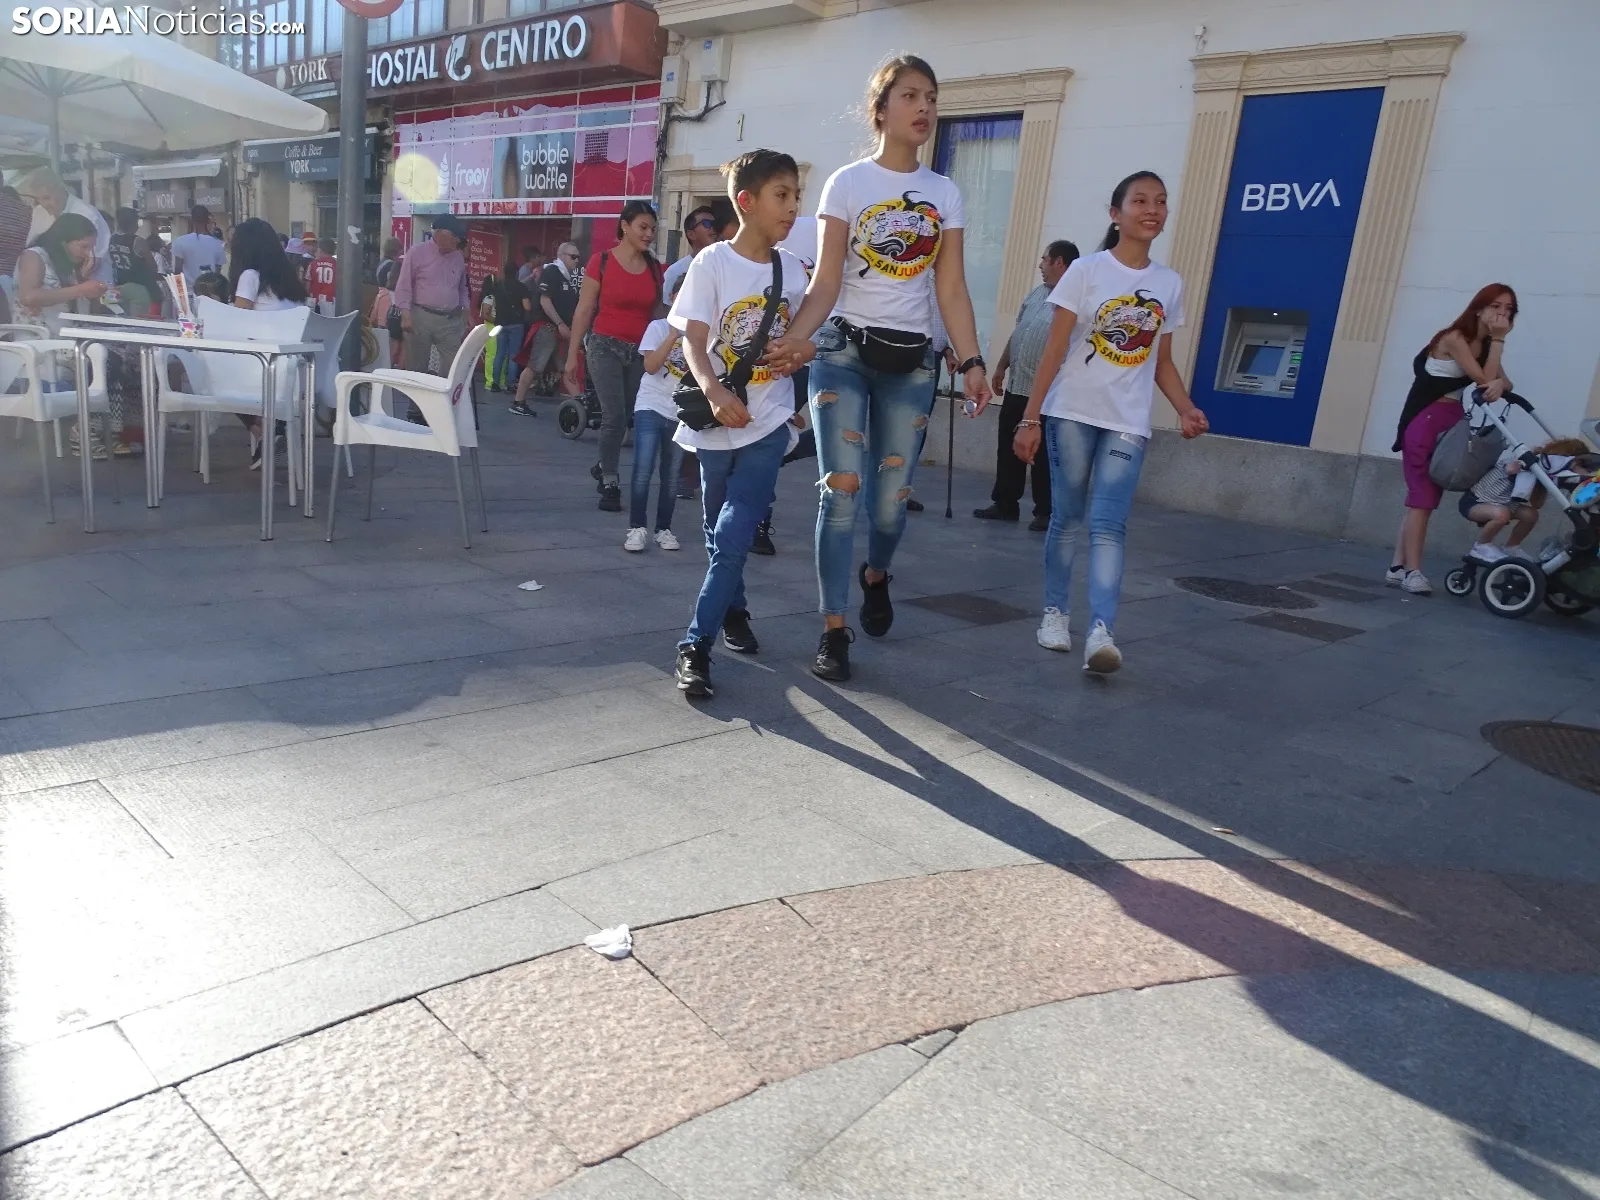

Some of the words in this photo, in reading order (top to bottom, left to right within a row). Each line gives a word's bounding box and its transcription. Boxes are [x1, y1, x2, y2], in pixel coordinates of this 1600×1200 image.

[480, 15, 587, 71] CENTRO
[290, 58, 328, 86] YORK
[522, 141, 569, 166] bubble
[289, 159, 310, 174] YORK
[525, 166, 568, 190] waffle
[156, 193, 176, 209] YORK
[1241, 178, 1341, 212] BBVA
[316, 266, 334, 284] 10
